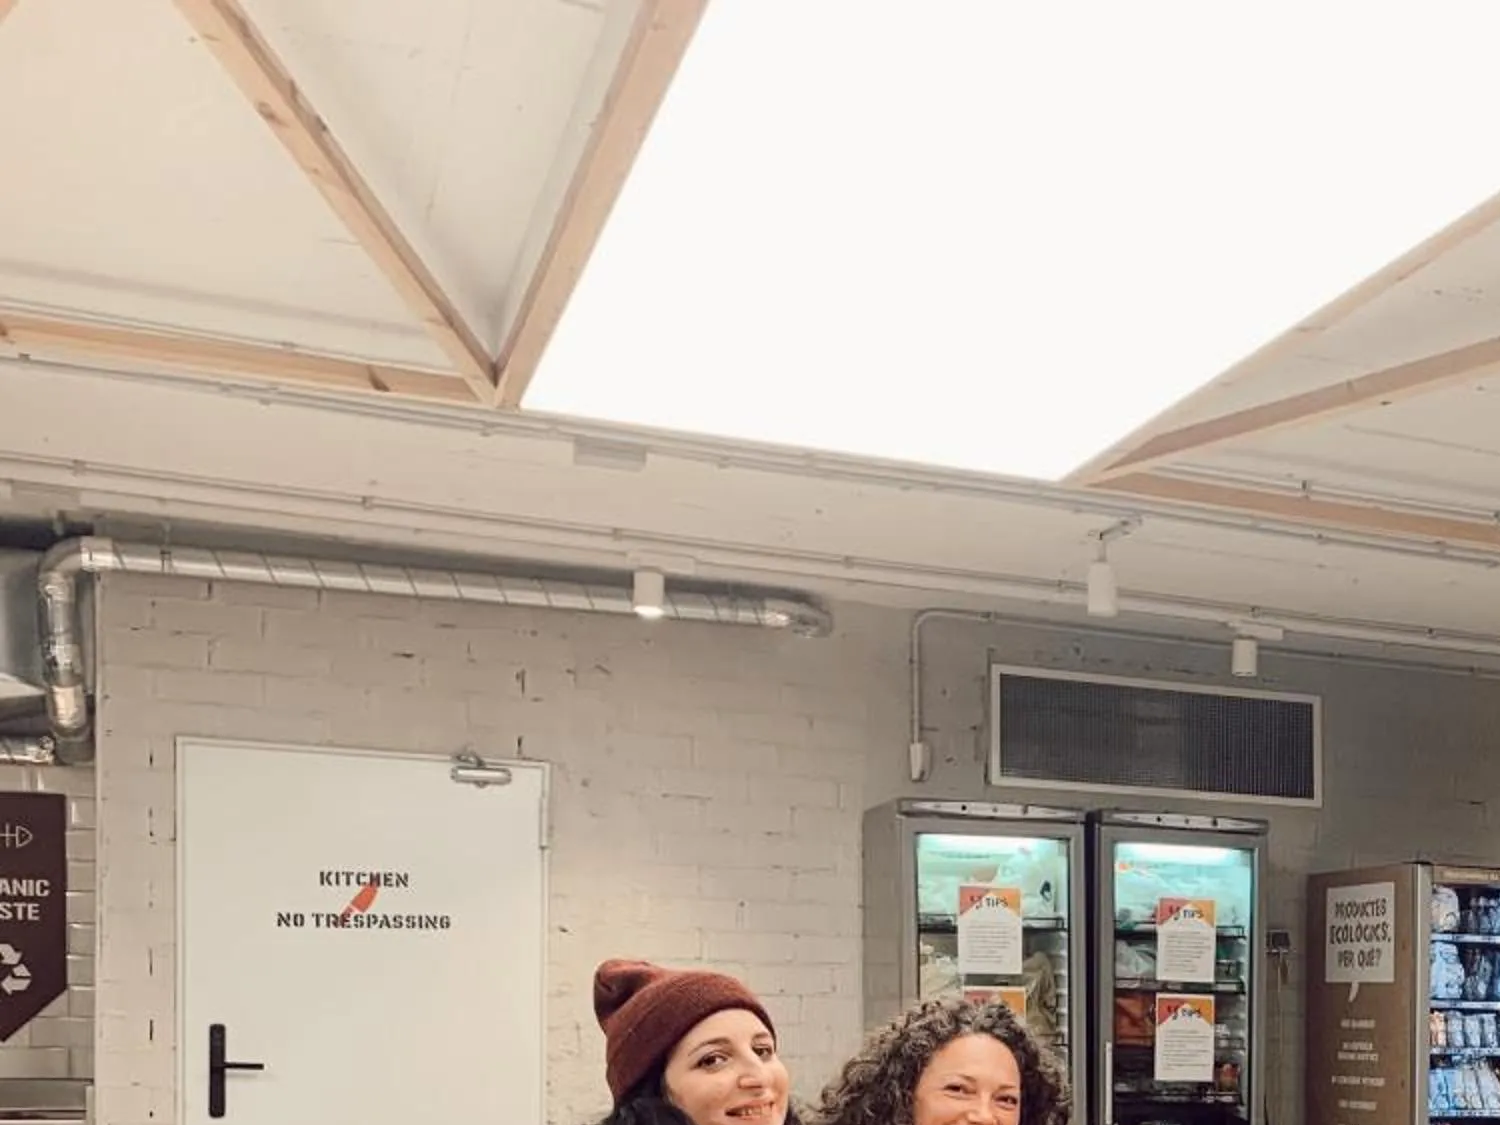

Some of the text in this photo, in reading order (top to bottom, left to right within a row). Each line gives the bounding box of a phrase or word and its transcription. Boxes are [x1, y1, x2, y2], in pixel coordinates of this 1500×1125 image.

[0, 879, 50, 897] ANIC
[319, 871, 409, 888] KITCHEN
[0, 903, 40, 921] STE
[277, 912, 451, 930] NO TRESPASSING
